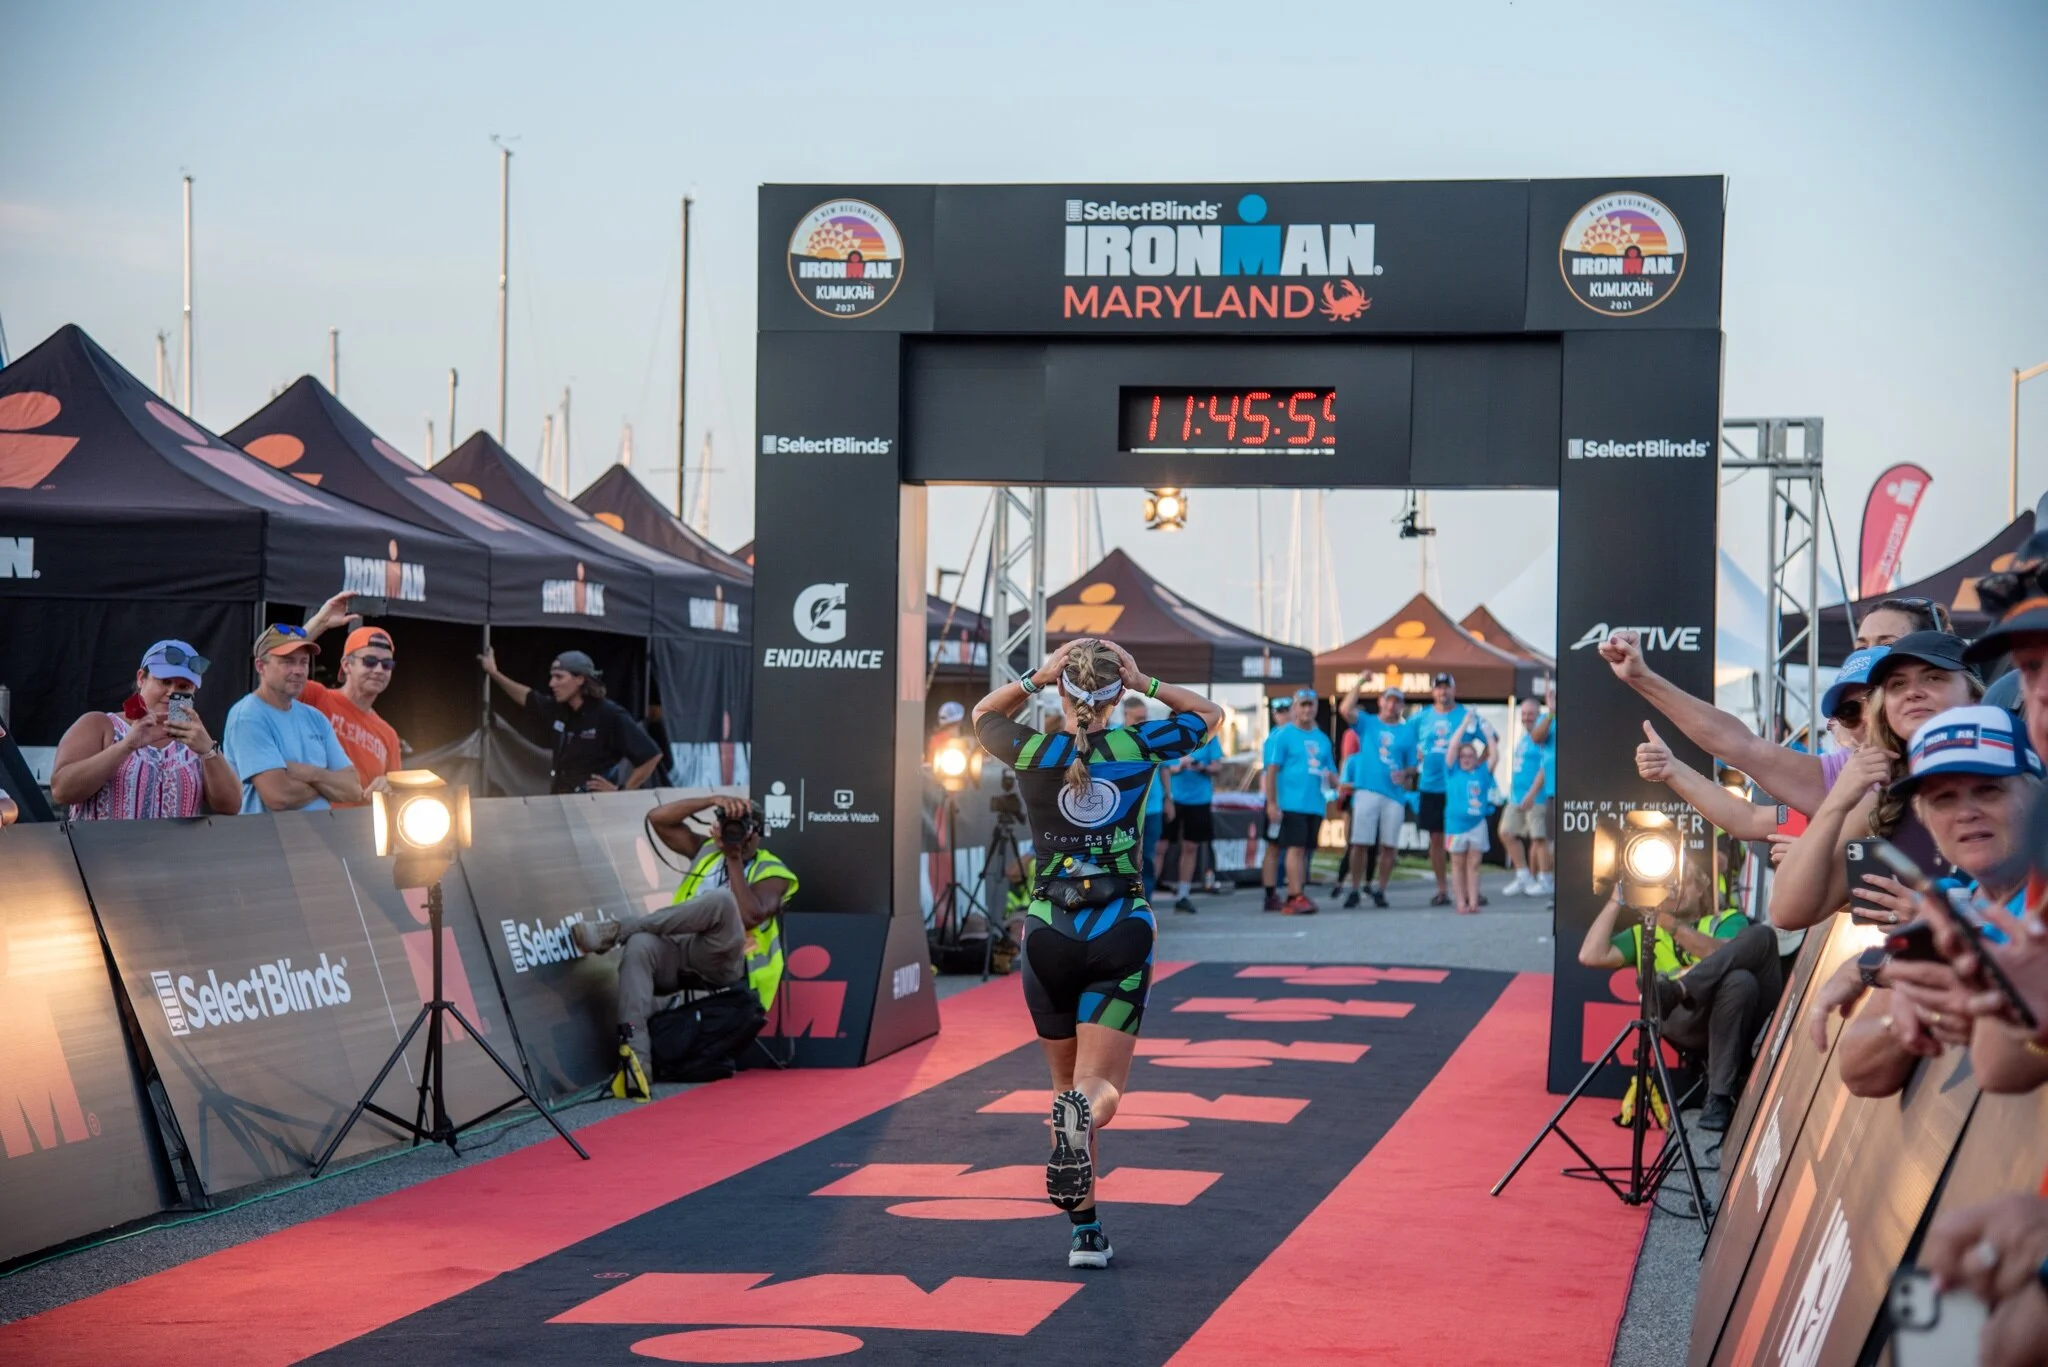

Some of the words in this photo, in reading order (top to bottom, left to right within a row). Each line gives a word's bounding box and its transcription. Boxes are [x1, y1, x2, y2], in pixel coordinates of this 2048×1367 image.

[820, 207, 837, 219] NEW
[840, 204, 880, 223] BEGINNING
[1083, 200, 1221, 221] SelectBlinds
[1596, 200, 1614, 212] NEW
[1618, 199, 1660, 217] BEGINNING
[1064, 223, 1376, 277] IRONMAN
[799, 261, 893, 279] IRONMAN
[1572, 257, 1674, 276] IRONMAN
[835, 303, 856, 312] 2021
[1063, 284, 1315, 319] MARYLAND
[1609, 300, 1632, 310] 2021
[777, 436, 892, 454] SelectBlinds
[1584, 439, 1710, 458] SelectBlinds
[763, 648, 884, 669] ENDURANCE
[1563, 800, 1594, 811] HEART
[1600, 801, 1613, 811] OF
[1619, 801, 1637, 811] THE
[1643, 802, 1699, 813] CHESAPEA
[807, 811, 850, 822] Facebook
[850, 811, 880, 823] Watch
[1044, 831, 1080, 843] Crew
[1085, 826, 1135, 842] Racing
[179, 953, 351, 1029] SelectBlinds
